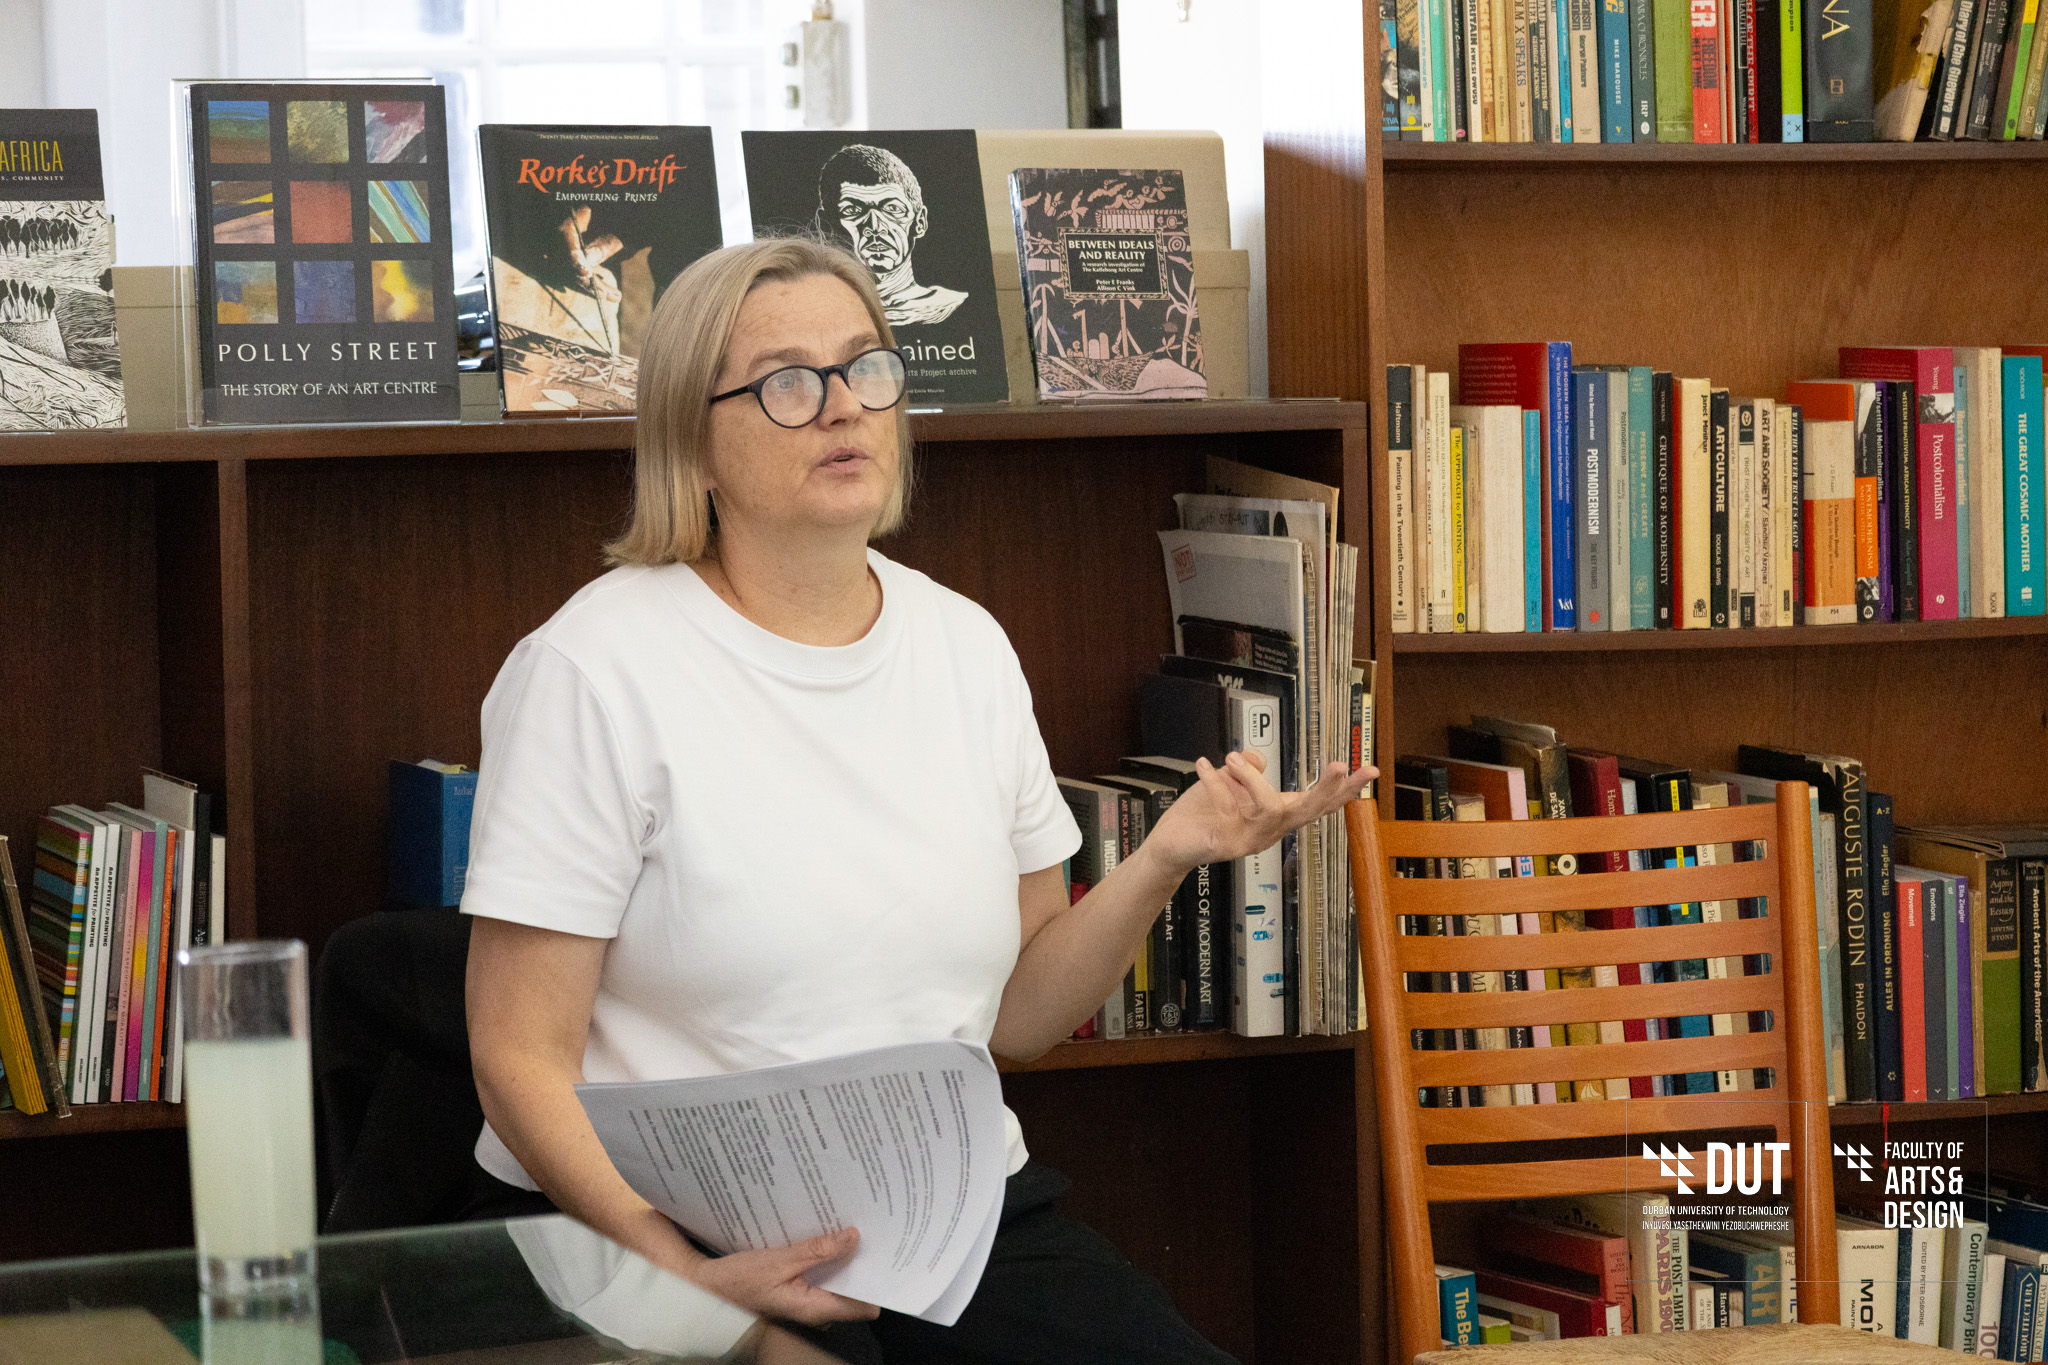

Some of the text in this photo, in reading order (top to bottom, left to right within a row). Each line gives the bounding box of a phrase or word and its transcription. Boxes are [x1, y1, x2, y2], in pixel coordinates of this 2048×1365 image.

[1515, 37, 1527, 87] SPEAKS
[1579, 35, 1587, 58] George
[1691, 37, 1702, 61] NEXT
[1942, 0, 1974, 114] Diary of Che Guevara
[1481, 29, 1493, 103] ENGLISH
[1702, 37, 1718, 89] FREEDOM
[1640, 100, 1649, 118] IRP
[0, 140, 64, 172] AFRICA
[517, 154, 687, 194] Rorke's Drift
[555, 192, 658, 203] EMPOWERING PRINTS
[1068, 240, 1155, 250] BETWEEN IDEALS
[1078, 250, 1146, 260] AND REALITY
[218, 341, 438, 362] POLLY STREET
[902, 336, 976, 361] ained
[920, 368, 977, 377] Project archive
[1931, 366, 1940, 391] Young
[220, 381, 438, 396] THE STORY OF AN ART CENTRE
[1761, 408, 1770, 432] ART
[1901, 390, 1909, 421] WESTERN
[1394, 401, 1403, 444] Haftmann
[1701, 394, 1709, 453] Janet Minihan
[1791, 411, 1799, 432] WILL
[1639, 431, 1647, 479] PRESERVE
[1761, 434, 1770, 459] AND
[1791, 434, 1799, 456] THEY
[1957, 443, 1966, 462] lost
[1715, 425, 1726, 513] ARTCULTURE
[1876, 434, 1885, 502] Multiculturalisms
[1932, 434, 1945, 520] Postcolonialism
[1586, 448, 1600, 536] POSTMODERNISM
[1957, 463, 1967, 506] aesthetic
[2017, 412, 2030, 573] THE GREAT COSMIC MOTHER
[1456, 502, 1462, 511] to
[1658, 435, 1668, 585] CRITIQUE OF MODERNITY
[1792, 507, 1799, 519] US
[1394, 456, 1405, 598] Painting in the Twentieth Century
[1865, 483, 1874, 570] POSTMODERNISM
[1744, 555, 1751, 566] OF
[1259, 713, 1271, 738] P
[1351, 693, 1362, 774] THE GIMMI
[1549, 792, 1557, 804] DE
[95, 867, 100, 876] An
[108, 866, 114, 876] An
[1104, 839, 1116, 876] MODE
[92, 876, 100, 908] APPETITE
[1842, 770, 1867, 1041] AUGUSTE RODIN PHAIDON
[1908, 888, 1916, 927] Movement
[1929, 887, 1937, 921] Emotions
[2032, 888, 2041, 930] Ancient
[89, 917, 97, 948] PAINTING
[102, 916, 110, 947] PAINTING
[1165, 924, 1174, 941] Art
[1198, 863, 1212, 1005] ORIES OF MODERN ART
[1881, 844, 1894, 1012] ALLES IN ORDNUNG Ella Ziegler
[2033, 931, 2041, 956] Arts
[2033, 956, 2042, 968] of
[2033, 968, 2042, 989] the
[1134, 993, 1144, 1028] FABER
[1672, 1236, 1680, 1254] THE
[1920, 1265, 1927, 1274] BY
[1962, 1233, 1983, 1325] Contemporary
[1454, 1287, 1472, 1346] The Be
[2019, 1282, 2034, 1357] ARQUITECTURA
[2035, 1282, 2048, 1330] PORTUGAL
